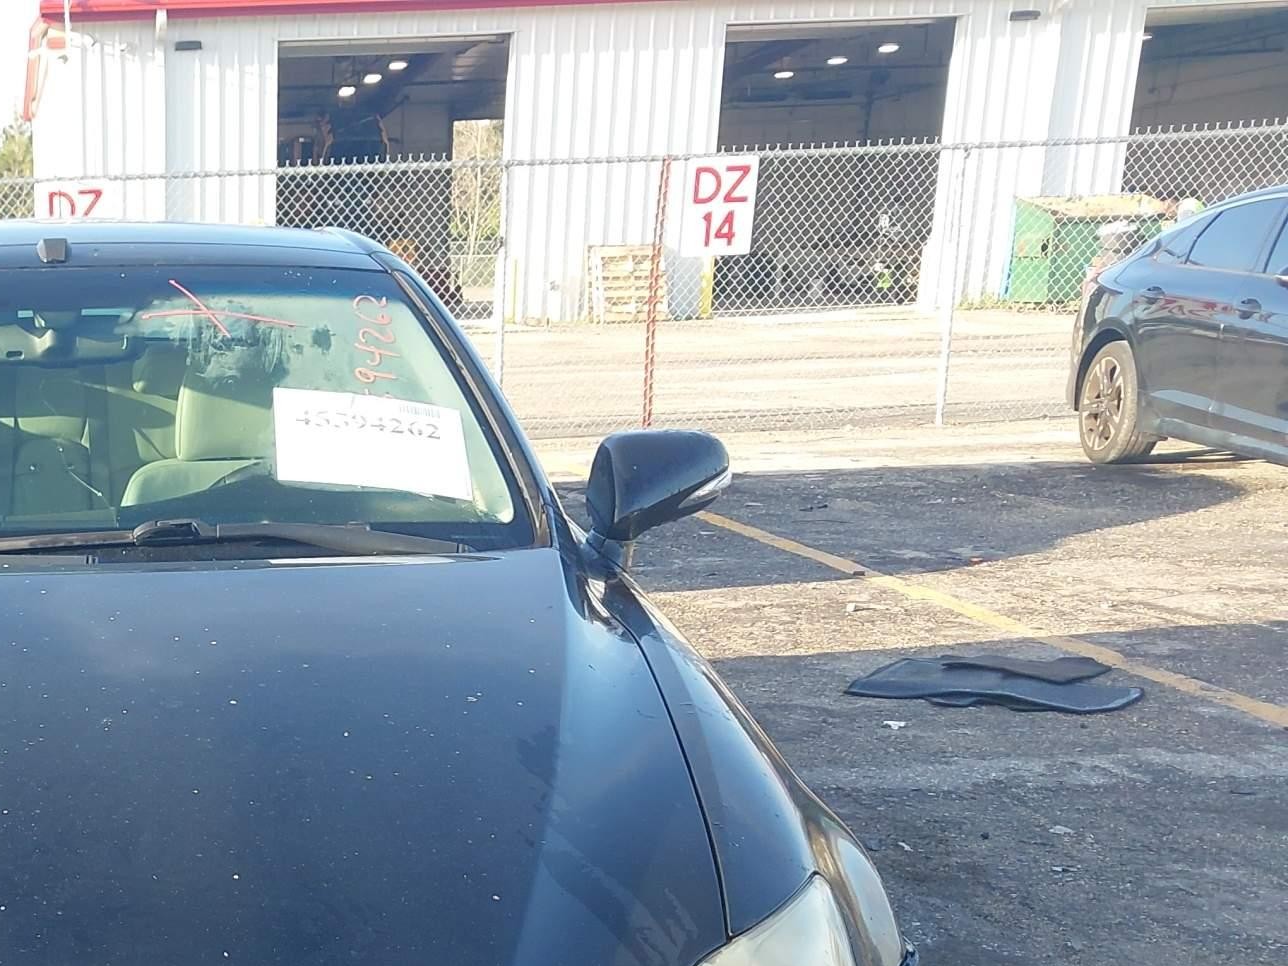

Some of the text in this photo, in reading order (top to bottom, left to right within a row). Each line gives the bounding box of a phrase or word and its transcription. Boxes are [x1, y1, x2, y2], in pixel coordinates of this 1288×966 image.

[693, 164, 752, 204] DZ
[702, 210, 736, 248] 14
[352, 294, 402, 398] 94262
